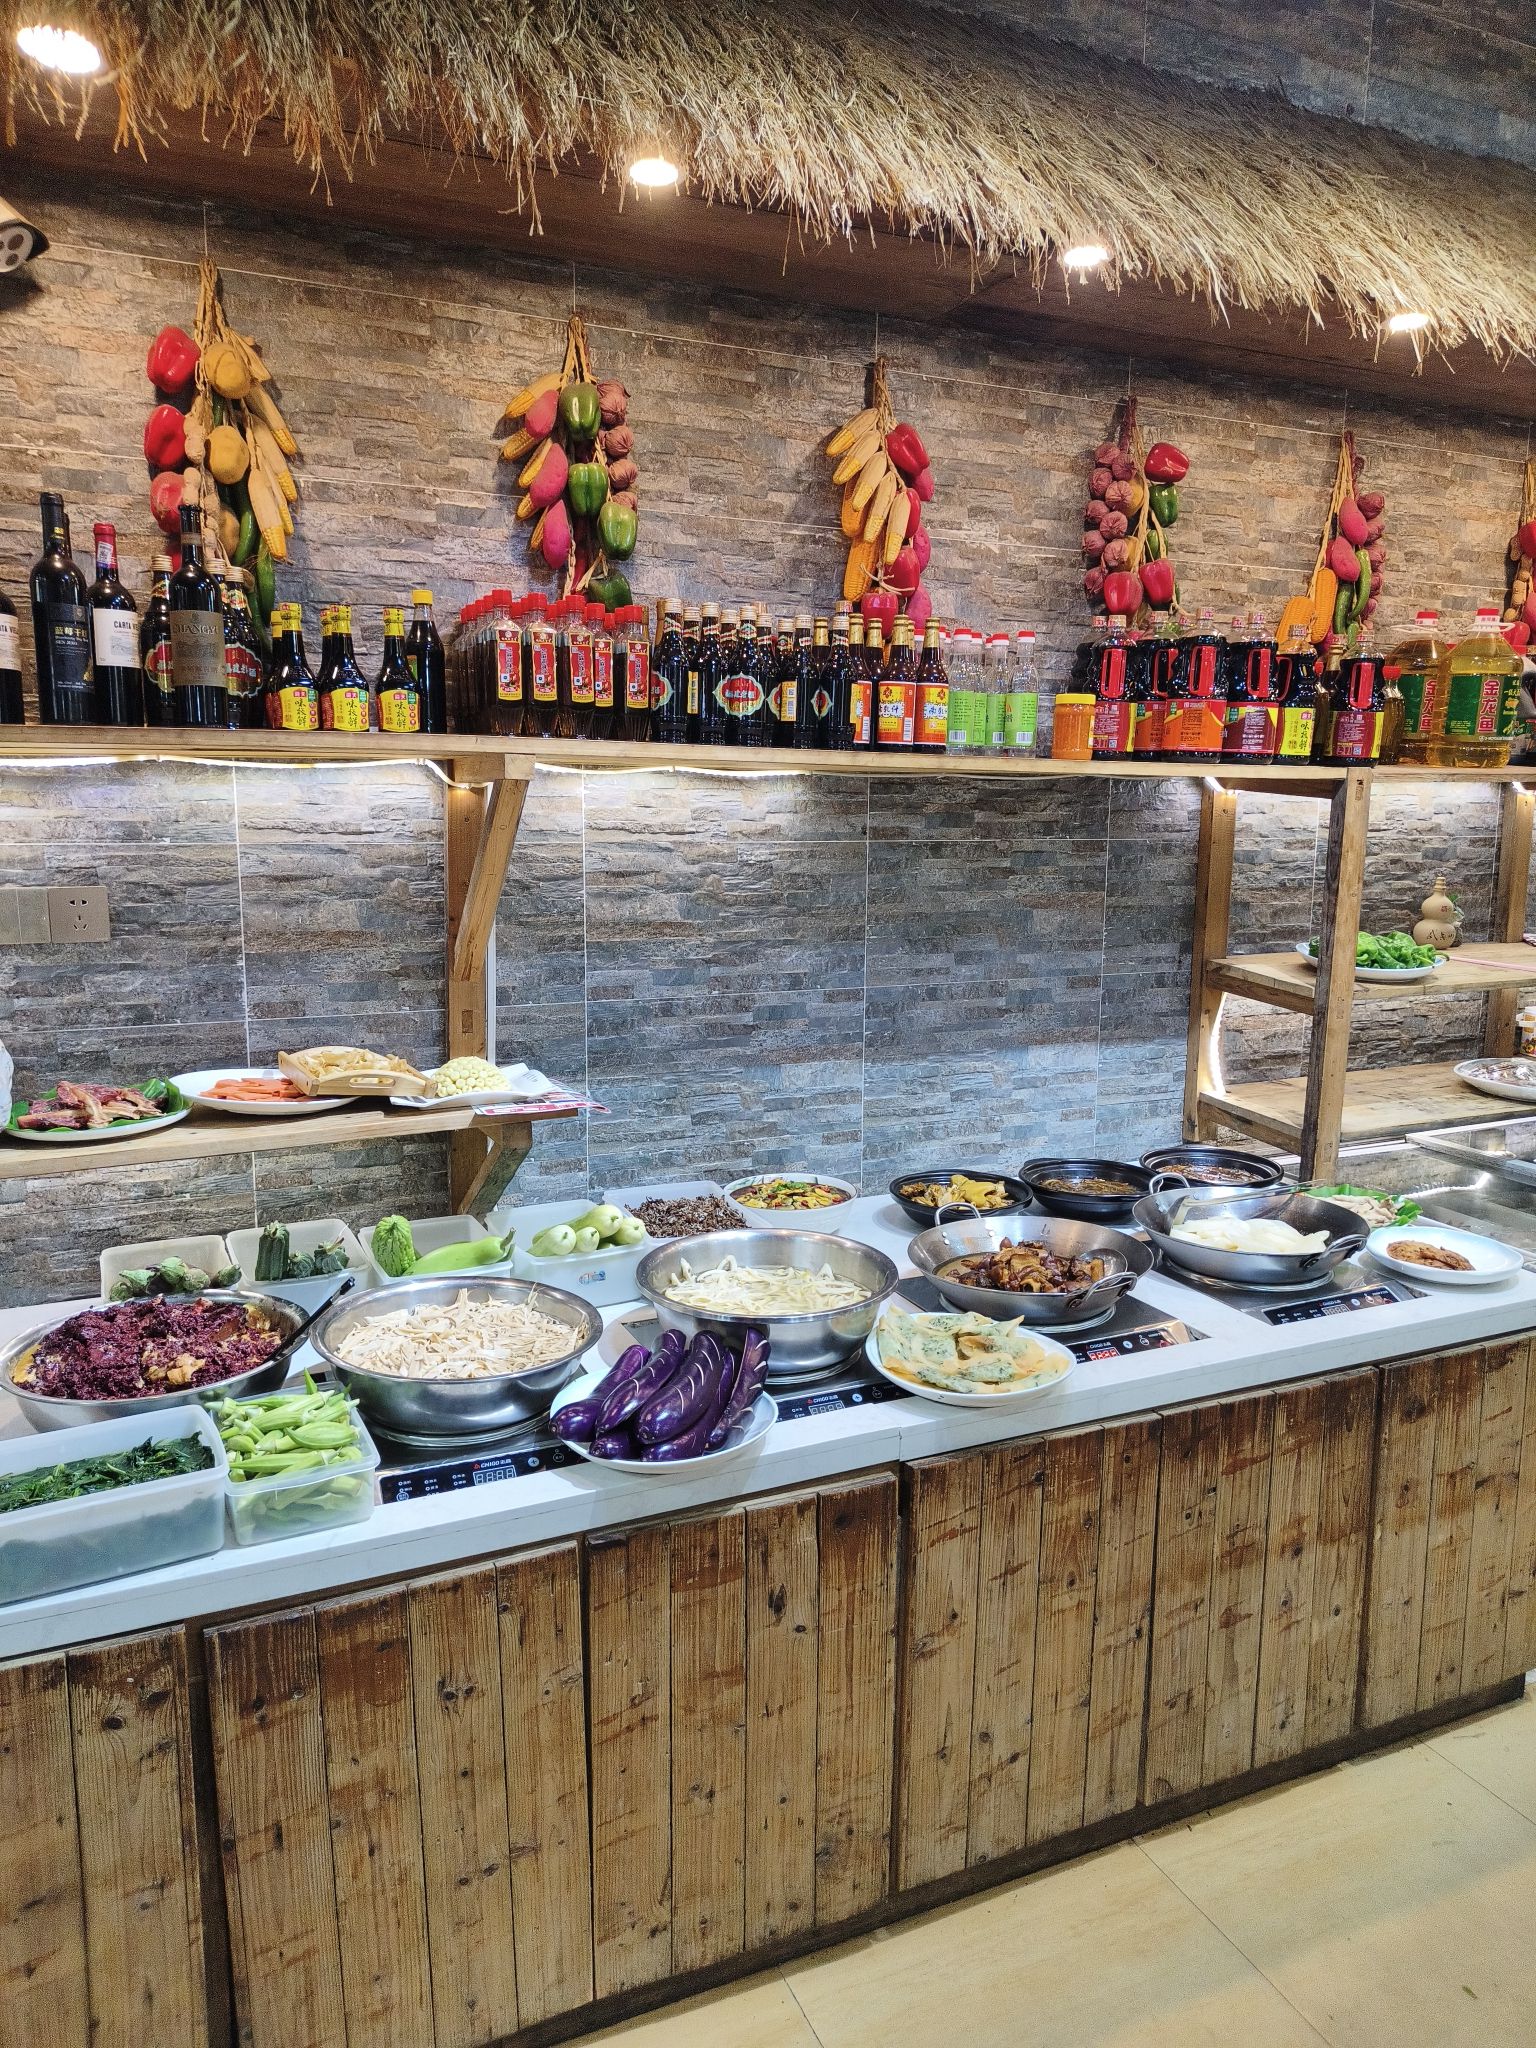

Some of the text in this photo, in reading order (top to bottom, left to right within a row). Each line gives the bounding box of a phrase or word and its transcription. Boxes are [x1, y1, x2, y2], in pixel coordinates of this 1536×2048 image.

[113, 620, 131, 630] CARTA
[1477, 679, 1502, 733] 金龙鱼
